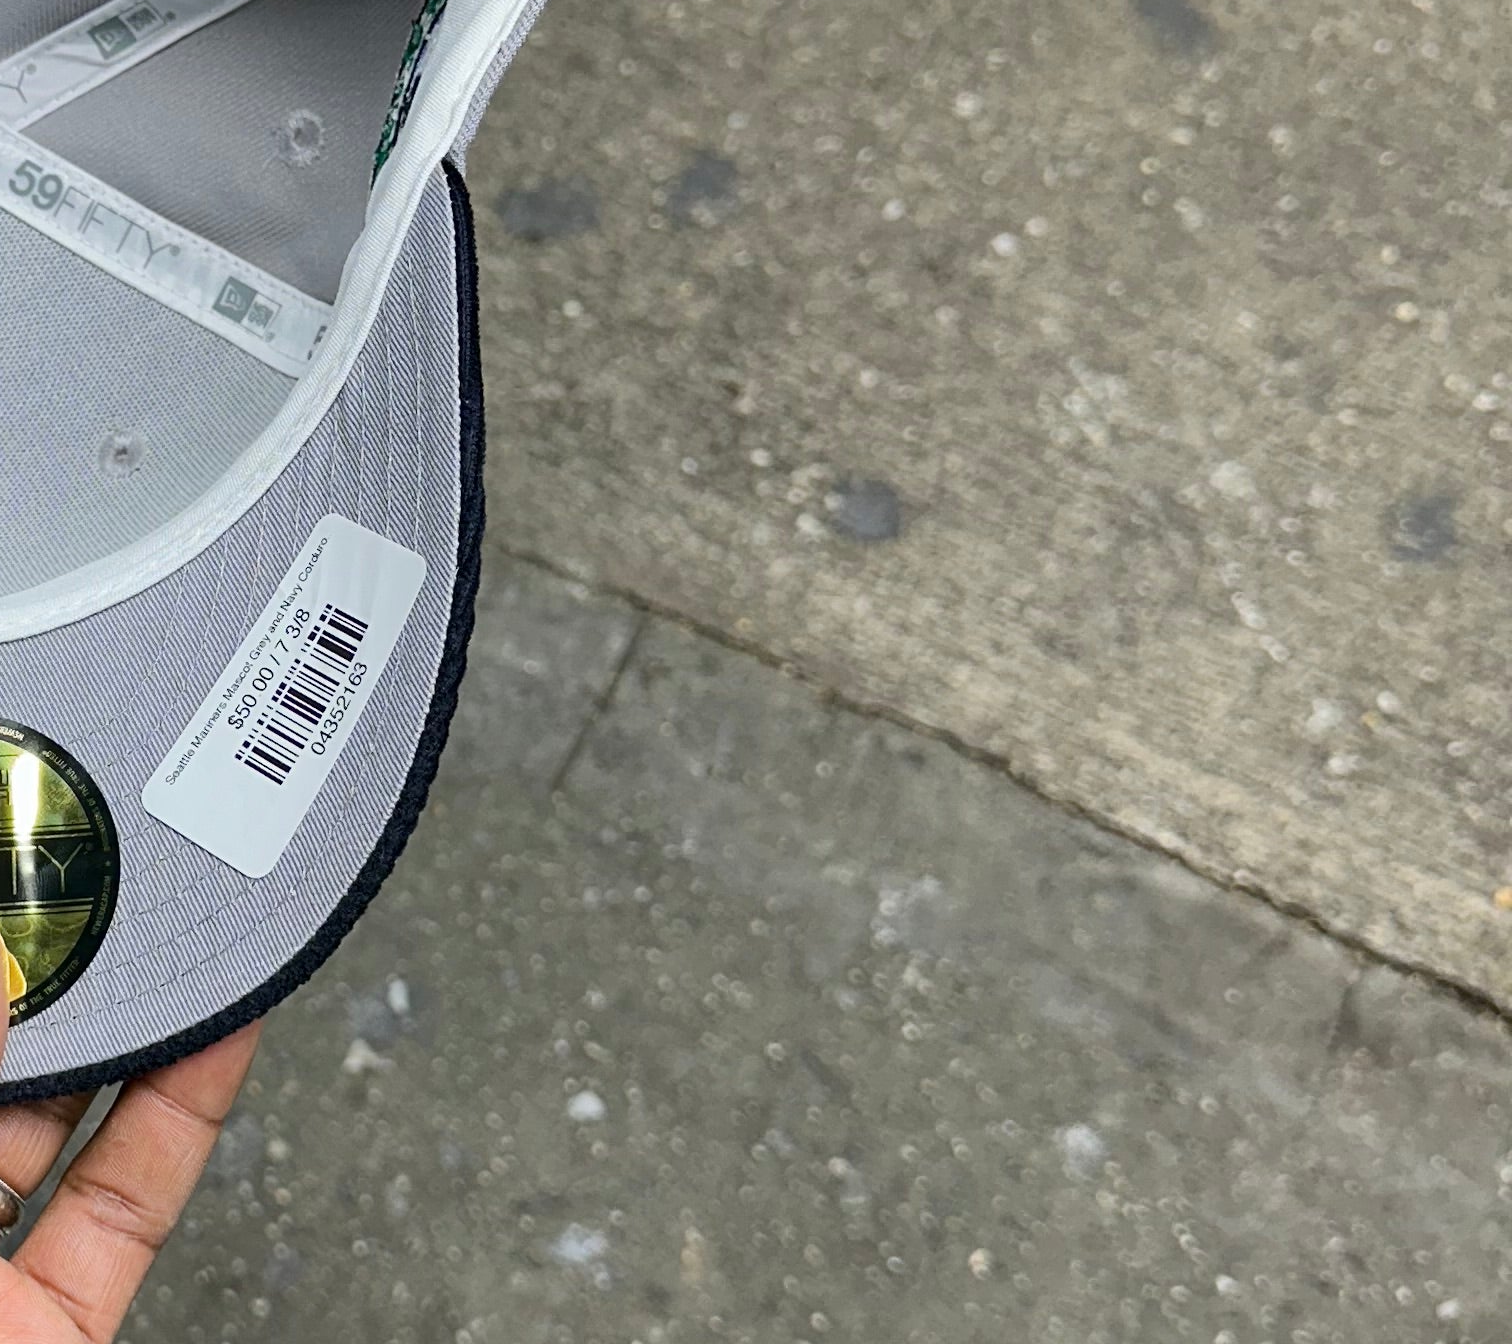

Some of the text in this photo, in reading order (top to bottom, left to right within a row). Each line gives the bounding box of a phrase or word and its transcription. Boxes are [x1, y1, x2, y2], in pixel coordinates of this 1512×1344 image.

[8, 159, 171, 270] 59FIFTY
[190, 701, 228, 748] Mariners
[248, 633, 272, 661] Grey
[268, 611, 285, 635] and
[279, 584, 304, 612] Navy
[297, 537, 329, 582] Corduro
[273, 638, 290, 653] 7
[284, 607, 311, 640] 3/8
[310, 661, 369, 757] 04352163
